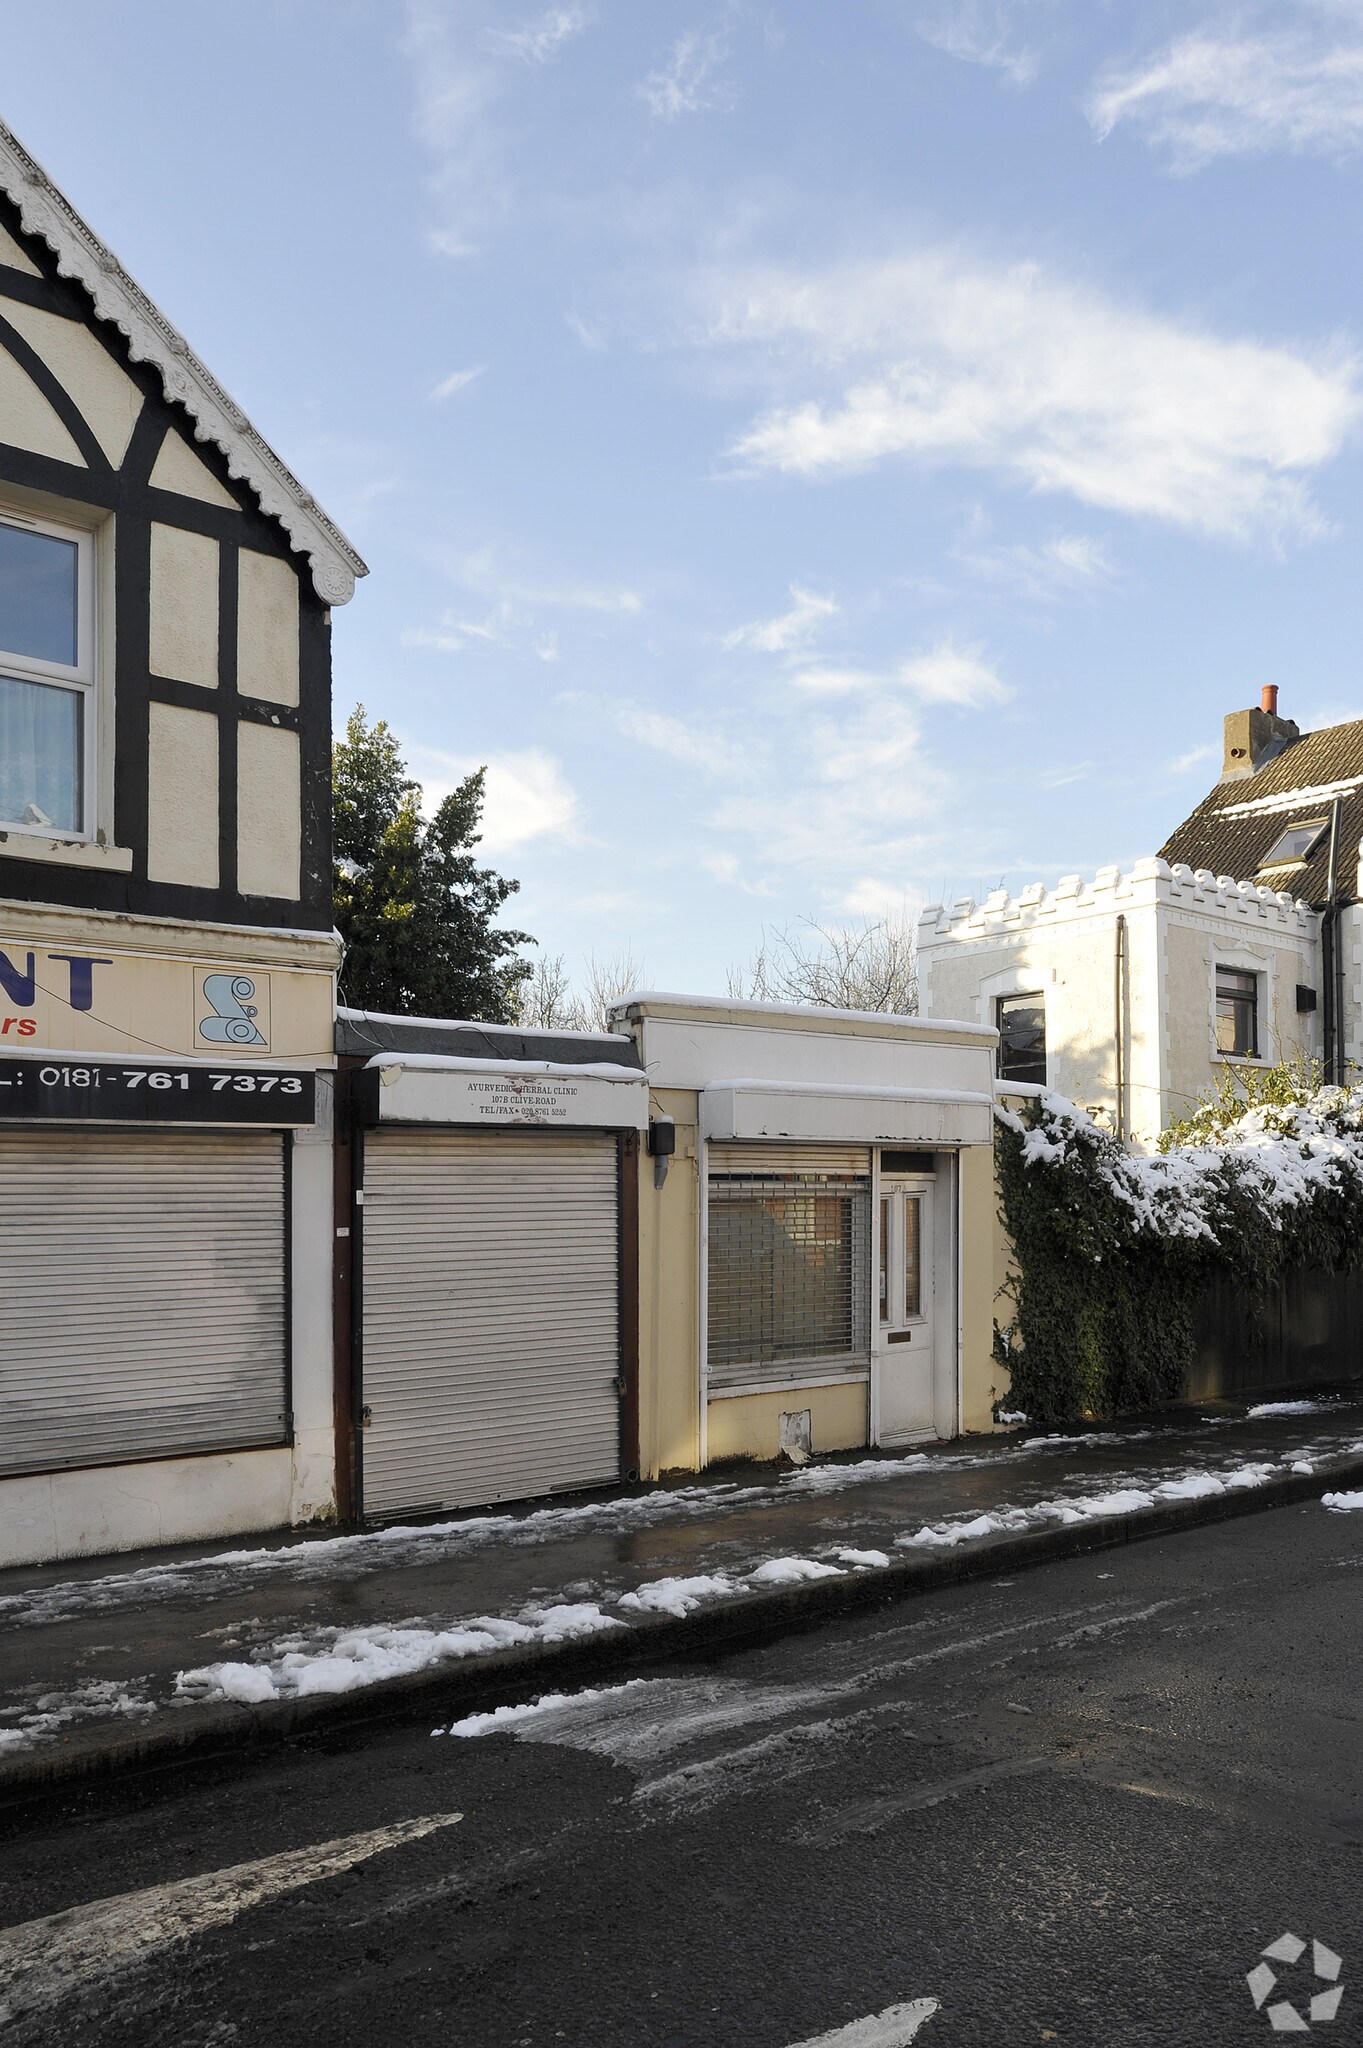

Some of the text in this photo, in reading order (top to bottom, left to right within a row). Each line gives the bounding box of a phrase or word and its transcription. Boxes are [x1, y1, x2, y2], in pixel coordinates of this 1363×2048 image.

[1, 1018, 37, 1036] rs
[208, 1075, 303, 1094] 7373
[467, 1083, 578, 1095] AYURVEDIC HERBAL CLINIC
[491, 1095, 557, 1105] 107B CLIVE ROAD
[551, 1108, 567, 1116] 5252
